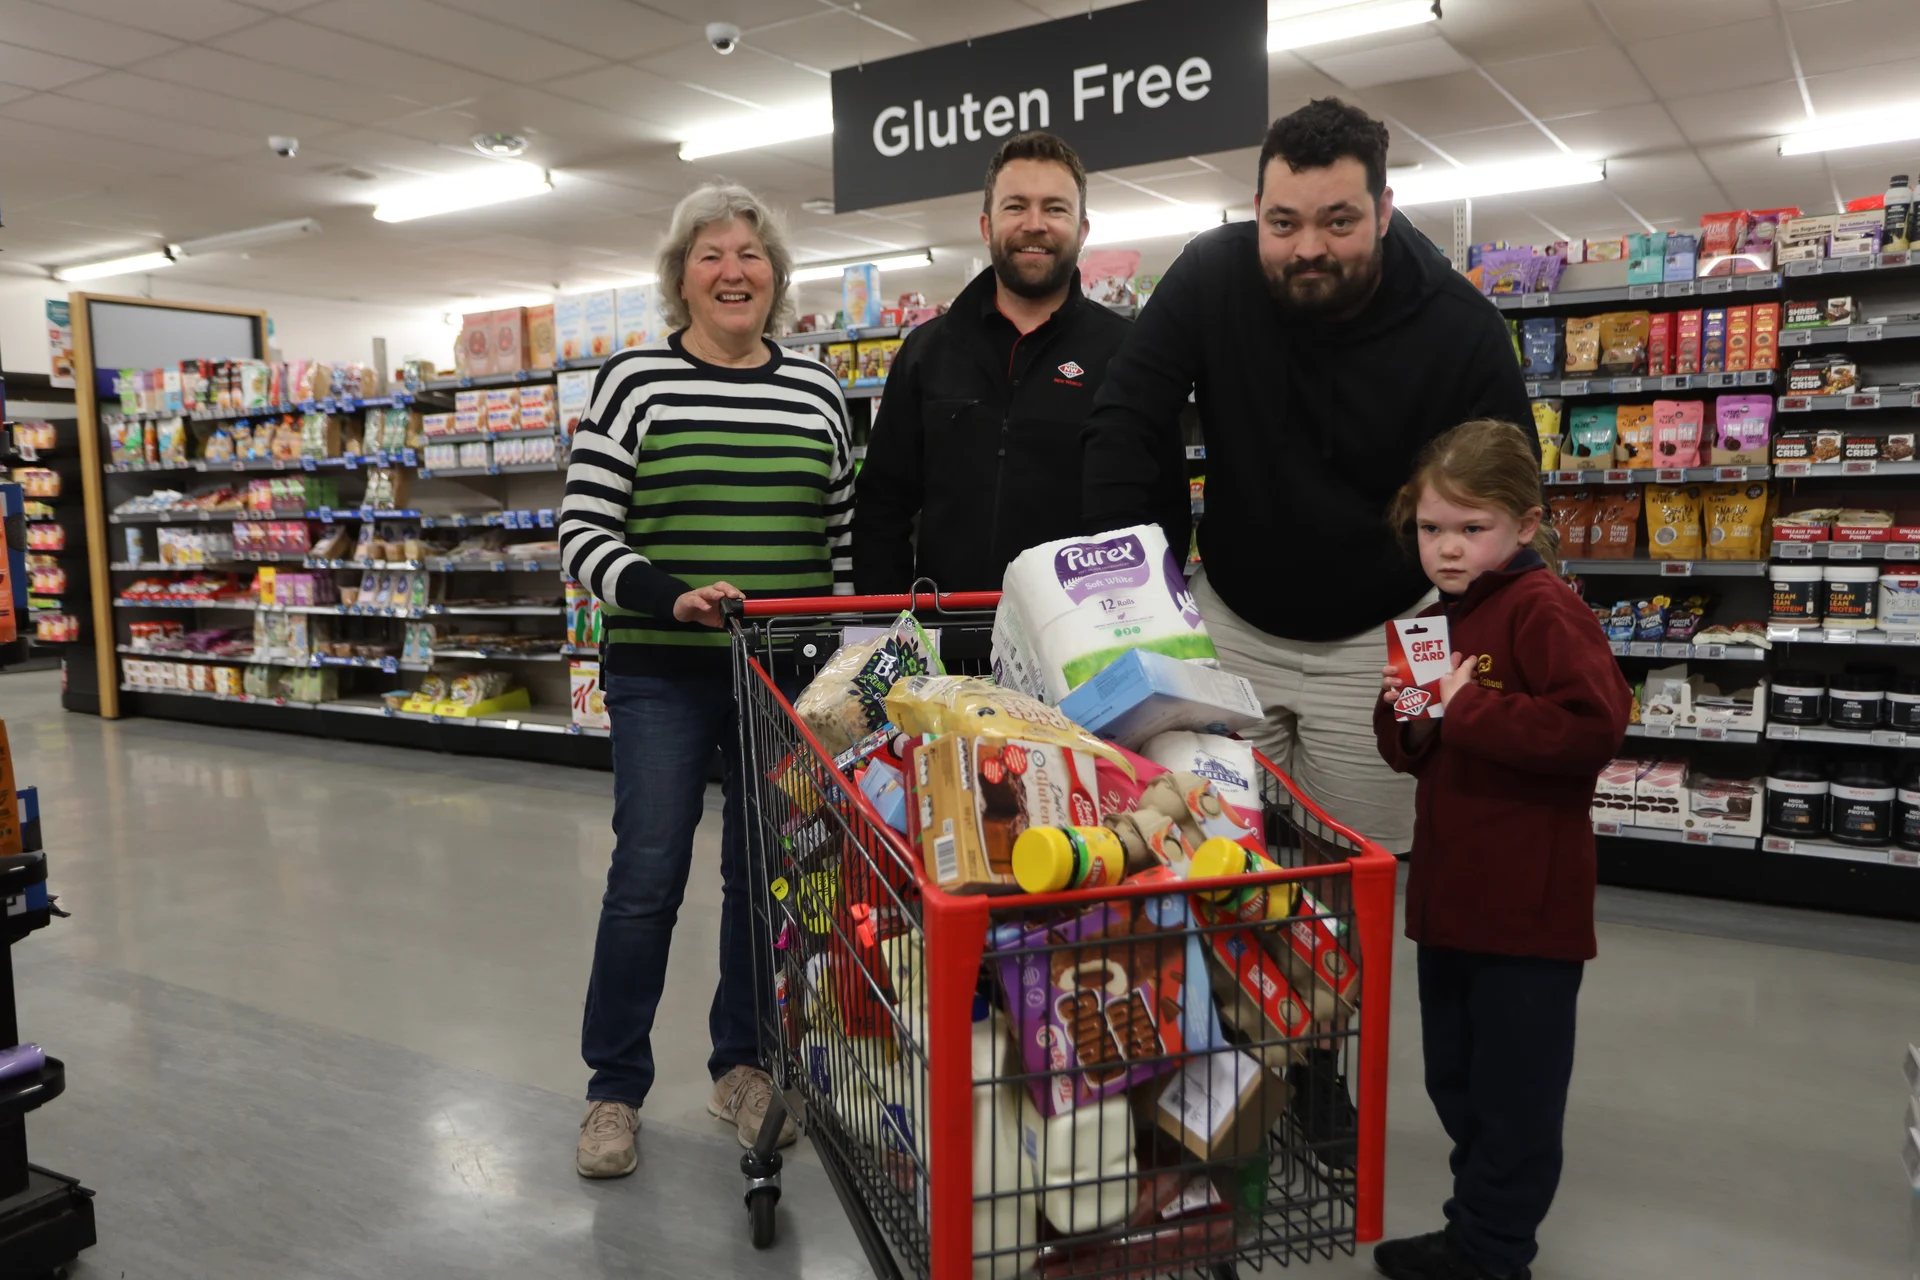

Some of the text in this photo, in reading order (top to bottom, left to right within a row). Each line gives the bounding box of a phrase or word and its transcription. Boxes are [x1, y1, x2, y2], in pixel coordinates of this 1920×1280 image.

[873, 56, 1212, 157] Gluten Free
[1788, 307, 1817, 316] SHRED
[1790, 381, 1821, 389] CRISP
[1776, 449, 1807, 457] CRISP
[1846, 449, 1878, 457] CRISP
[1060, 543, 1135, 571] Purex
[1085, 576, 1134, 590] Soft White
[1099, 599, 1135, 611] 12 Rolls
[1411, 640, 1443, 652] GIFT
[1413, 651, 1445, 662] CARD
[573, 679, 595, 714] K
[1402, 694, 1422, 709] NW
[1198, 771, 1244, 786] CHELSEA
[1035, 769, 1050, 825] Gluten
